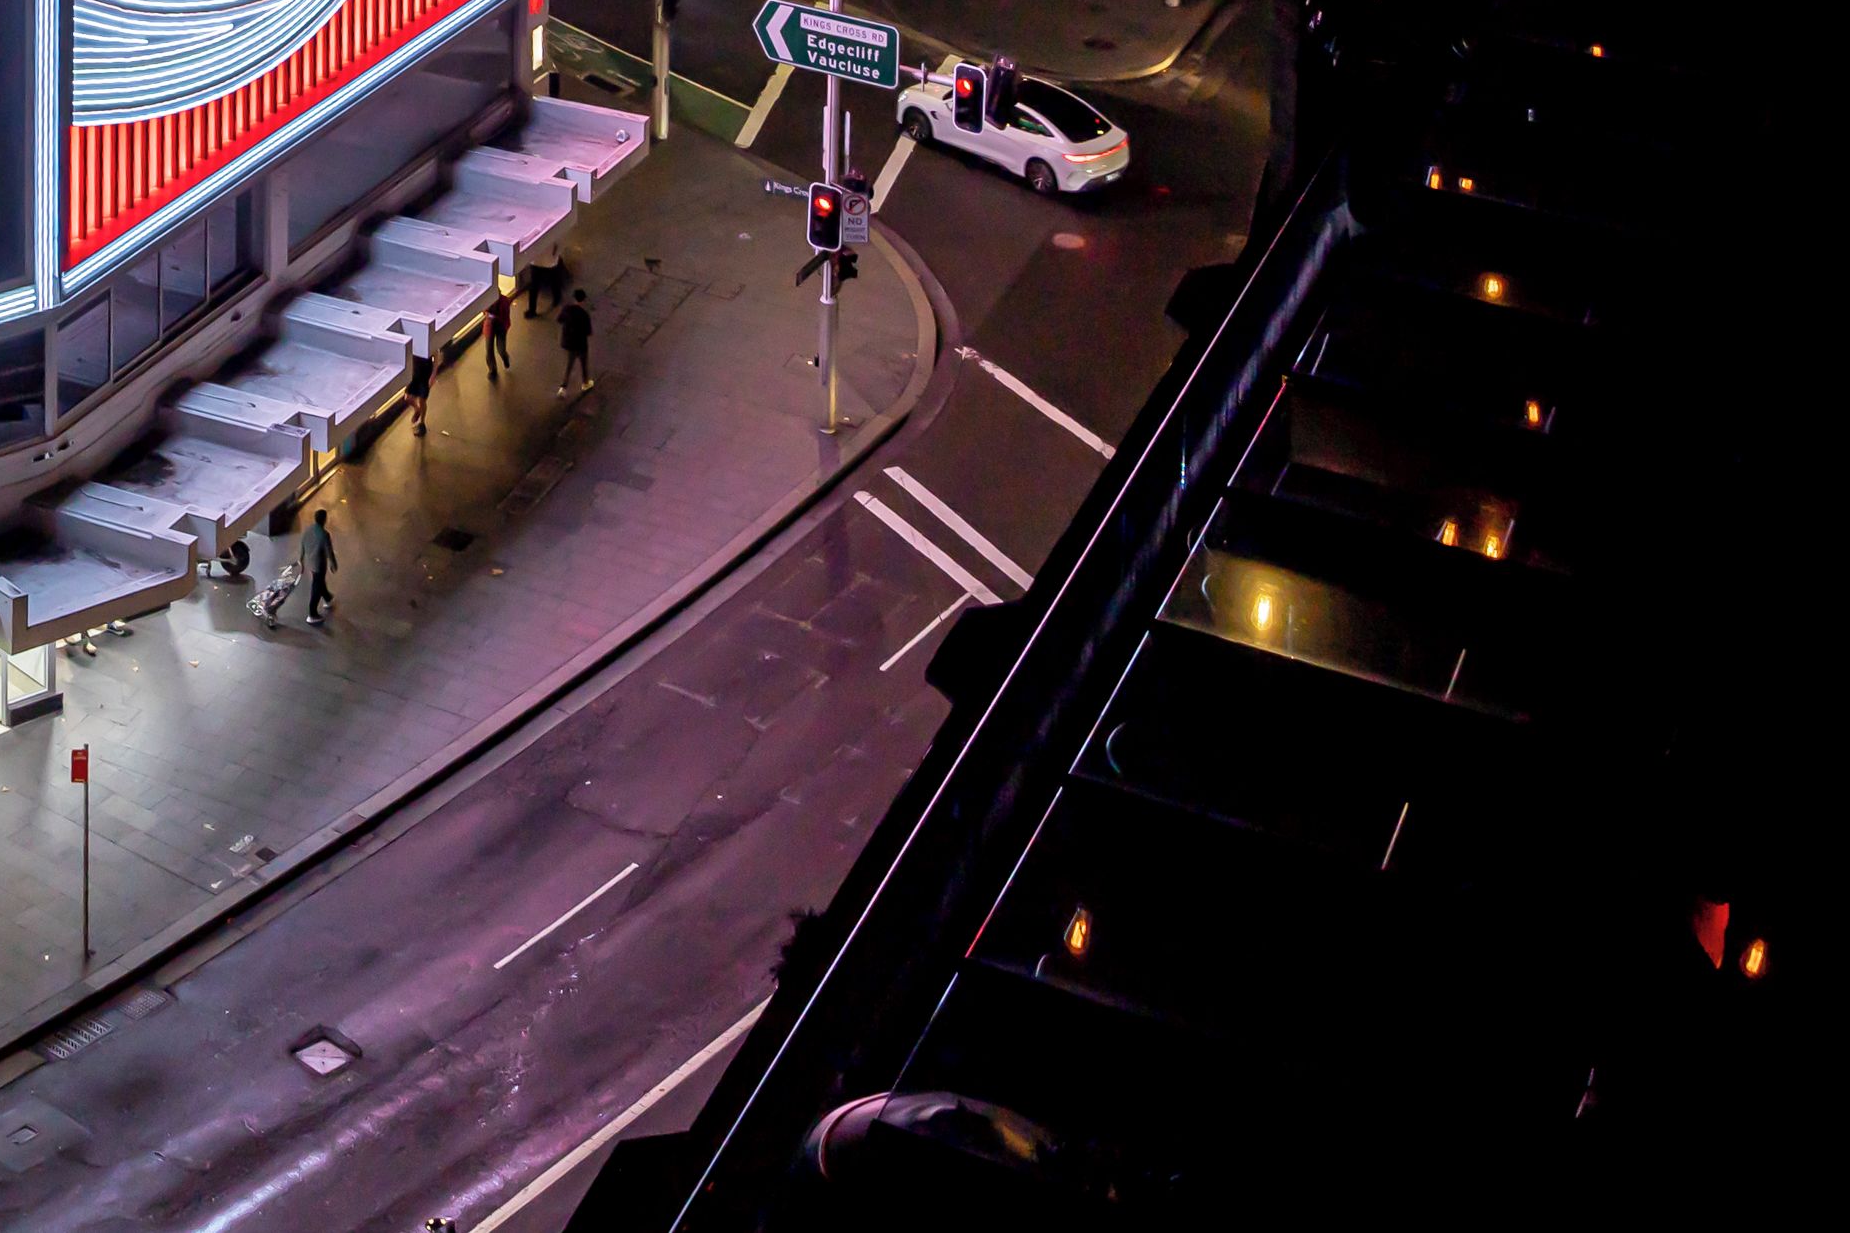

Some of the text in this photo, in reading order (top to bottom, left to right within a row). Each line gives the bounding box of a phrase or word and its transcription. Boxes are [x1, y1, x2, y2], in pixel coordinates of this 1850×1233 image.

[803, 16, 885, 43] KINGS CROSS RD
[807, 34, 880, 62] Edgecliff
[807, 50, 880, 80] Vaucluse
[847, 217, 863, 226] NO
